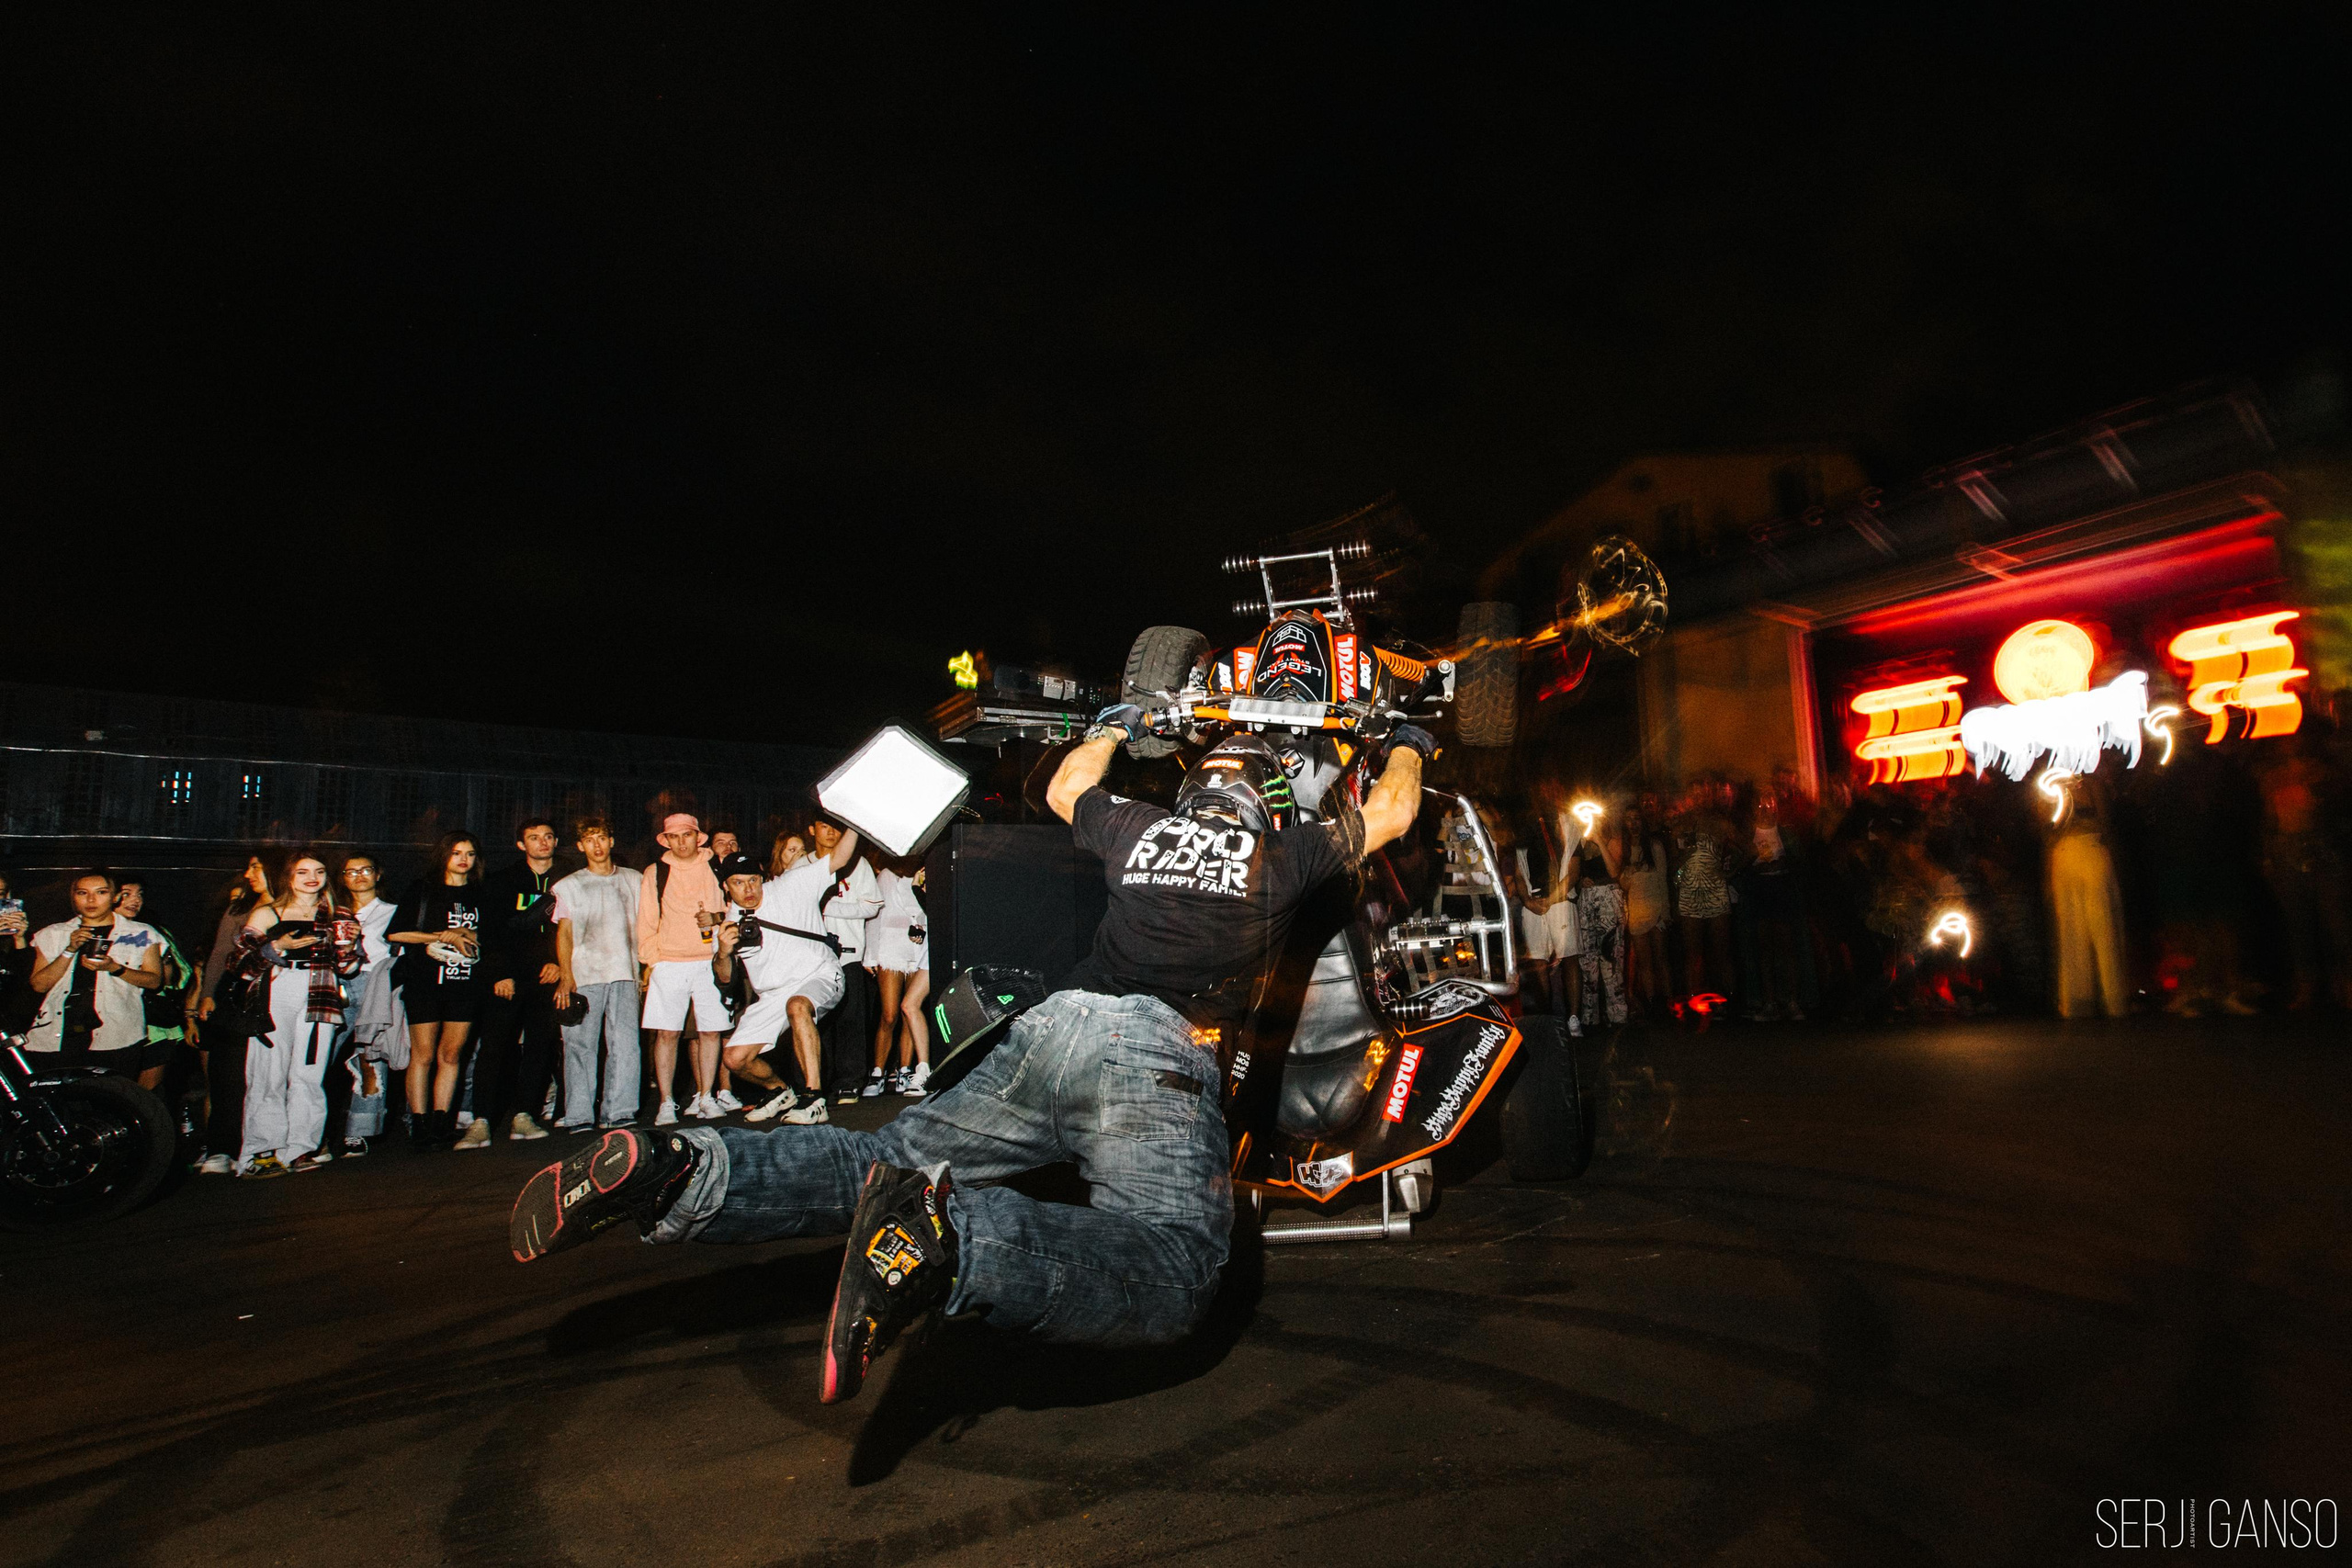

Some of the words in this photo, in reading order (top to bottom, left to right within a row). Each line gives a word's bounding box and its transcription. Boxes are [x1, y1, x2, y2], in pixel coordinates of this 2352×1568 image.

[1274, 644, 1303, 652] MOTUL
[1338, 637, 1354, 698] MOTUL
[1258, 662, 1321, 682] LEGEND
[1141, 817, 1255, 861] PRO
[1122, 873, 1151, 886] HUGE
[1152, 874, 1197, 888] HAPPY
[1125, 840, 1249, 888] RIDER
[1386, 1048, 1419, 1119] MOTUL
